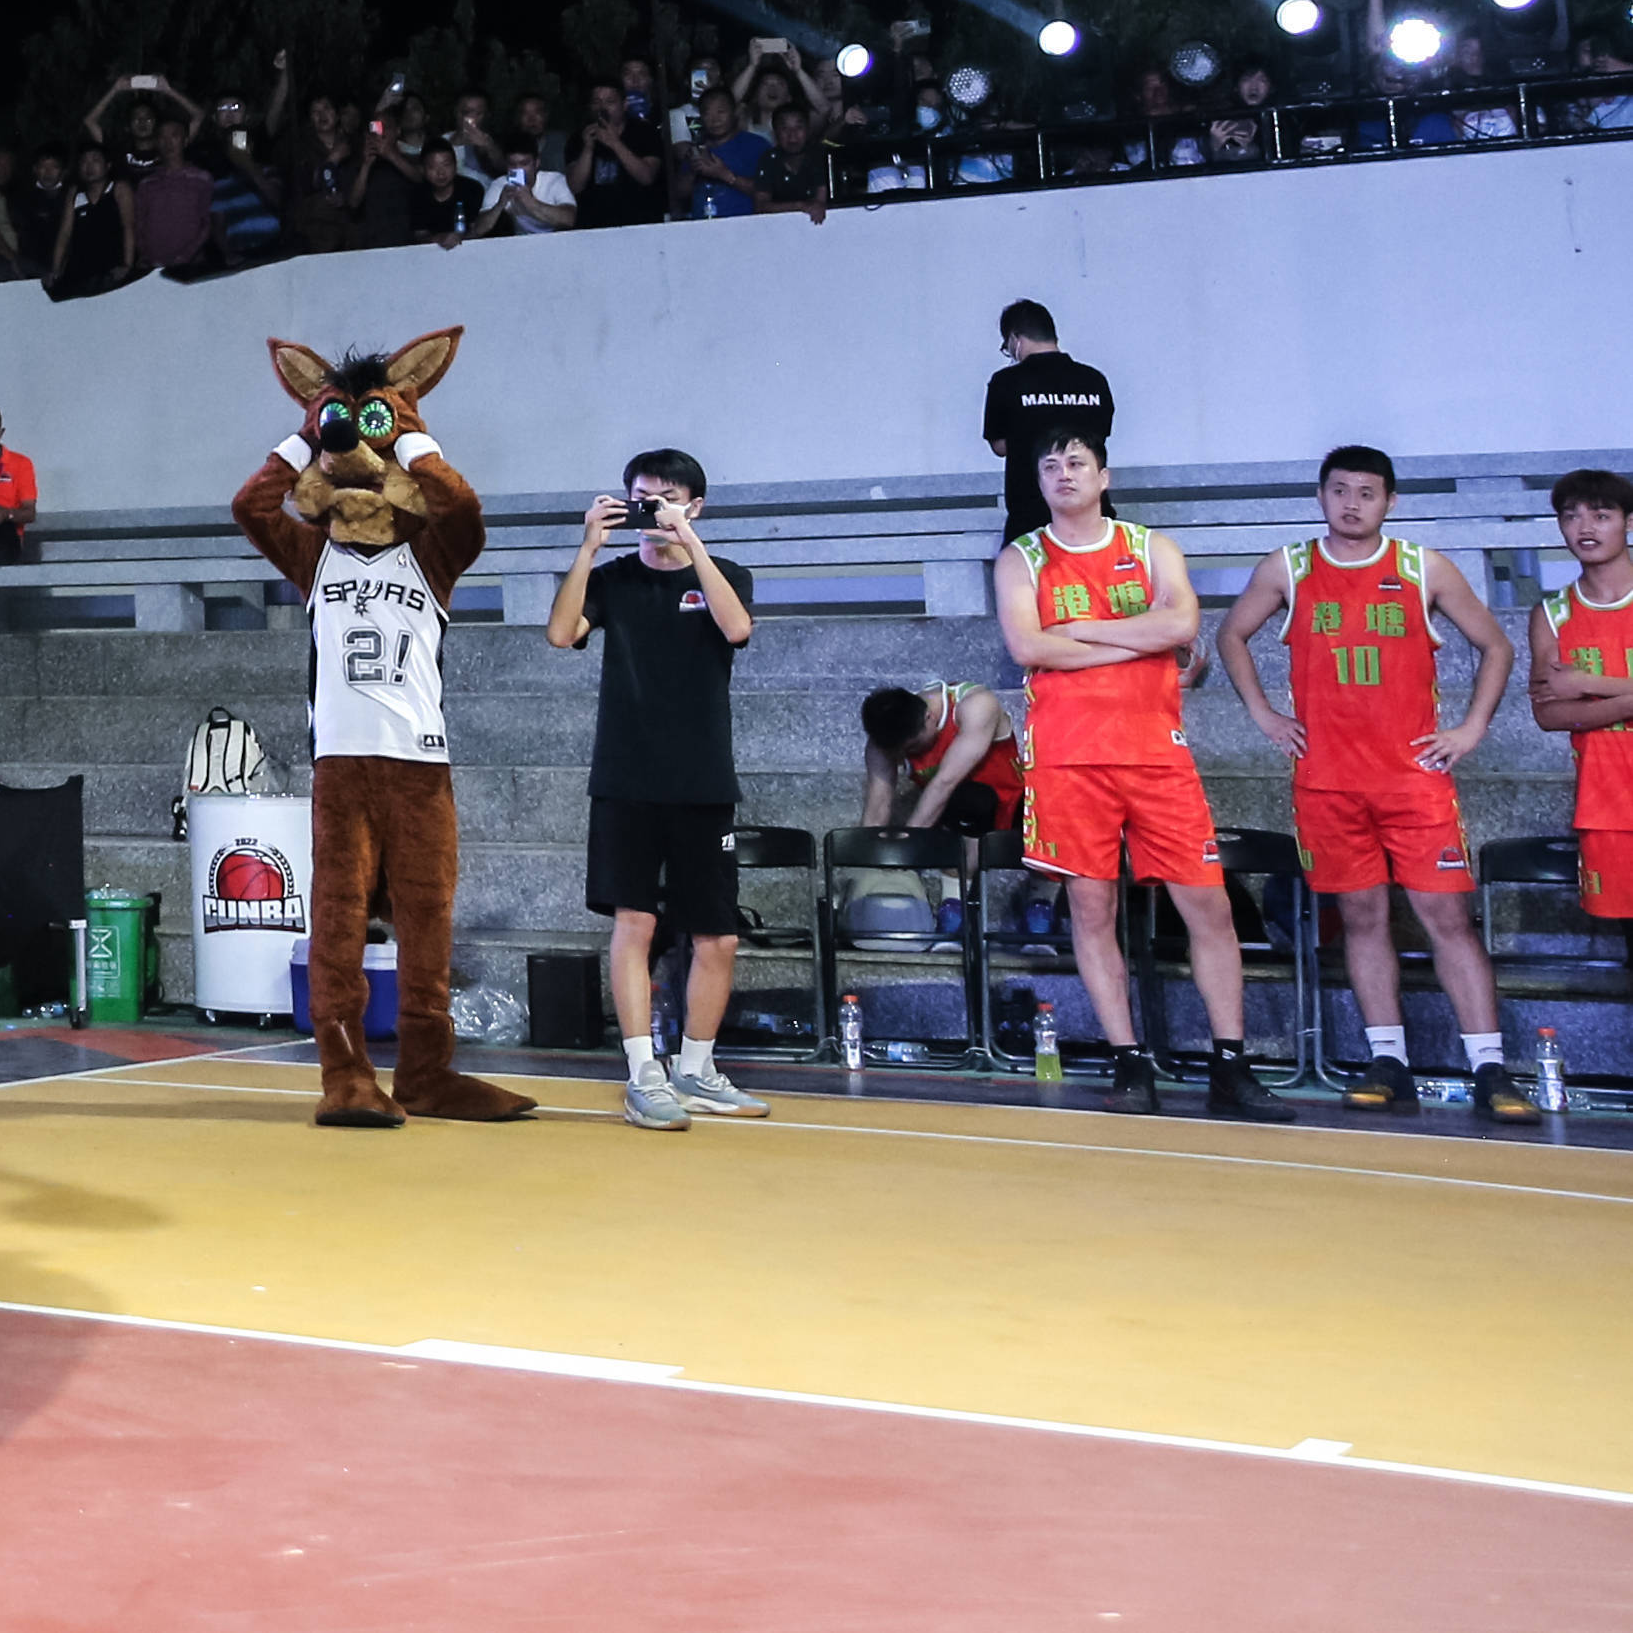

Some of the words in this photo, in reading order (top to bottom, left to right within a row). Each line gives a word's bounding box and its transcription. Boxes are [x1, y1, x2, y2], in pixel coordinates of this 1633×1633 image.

[1021, 393, 1101, 407] MAILMAN
[322, 579, 426, 613] SPURS
[1311, 601, 1407, 638] 港塘
[1331, 645, 1381, 685] 10
[235, 838, 258, 847] 2022
[204, 896, 305, 929] CUNBA
